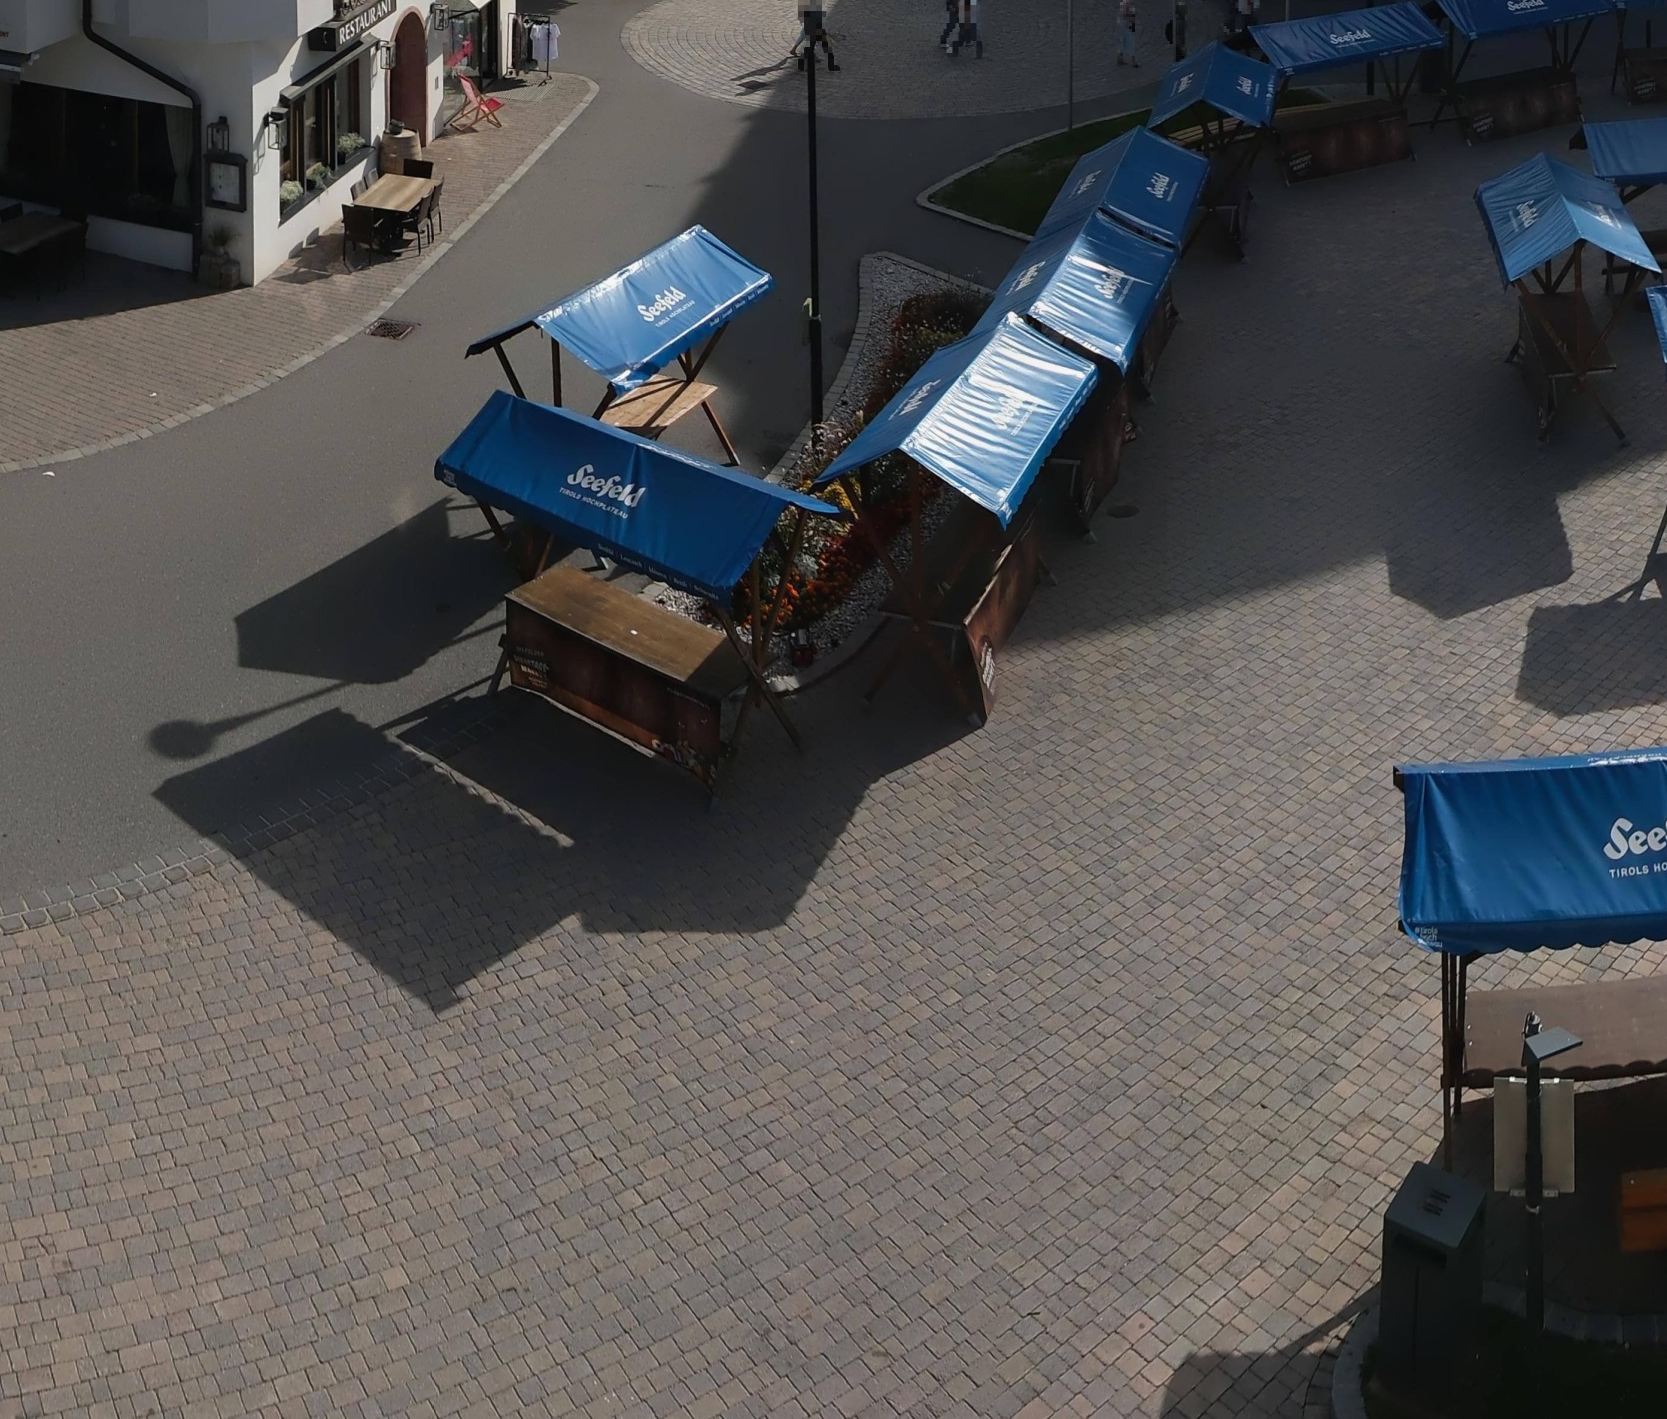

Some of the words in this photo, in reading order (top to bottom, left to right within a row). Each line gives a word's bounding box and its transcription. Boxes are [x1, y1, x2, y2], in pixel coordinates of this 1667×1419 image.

[1330, 30, 1371, 45] Seefeld
[637, 287, 687, 322] Seefeld
[559, 486, 582, 502] TIROLS
[582, 496, 629, 520] HOCHPLATEAU
[566, 465, 647, 508] Seefeld
[1609, 865, 1648, 880] TIROLS
